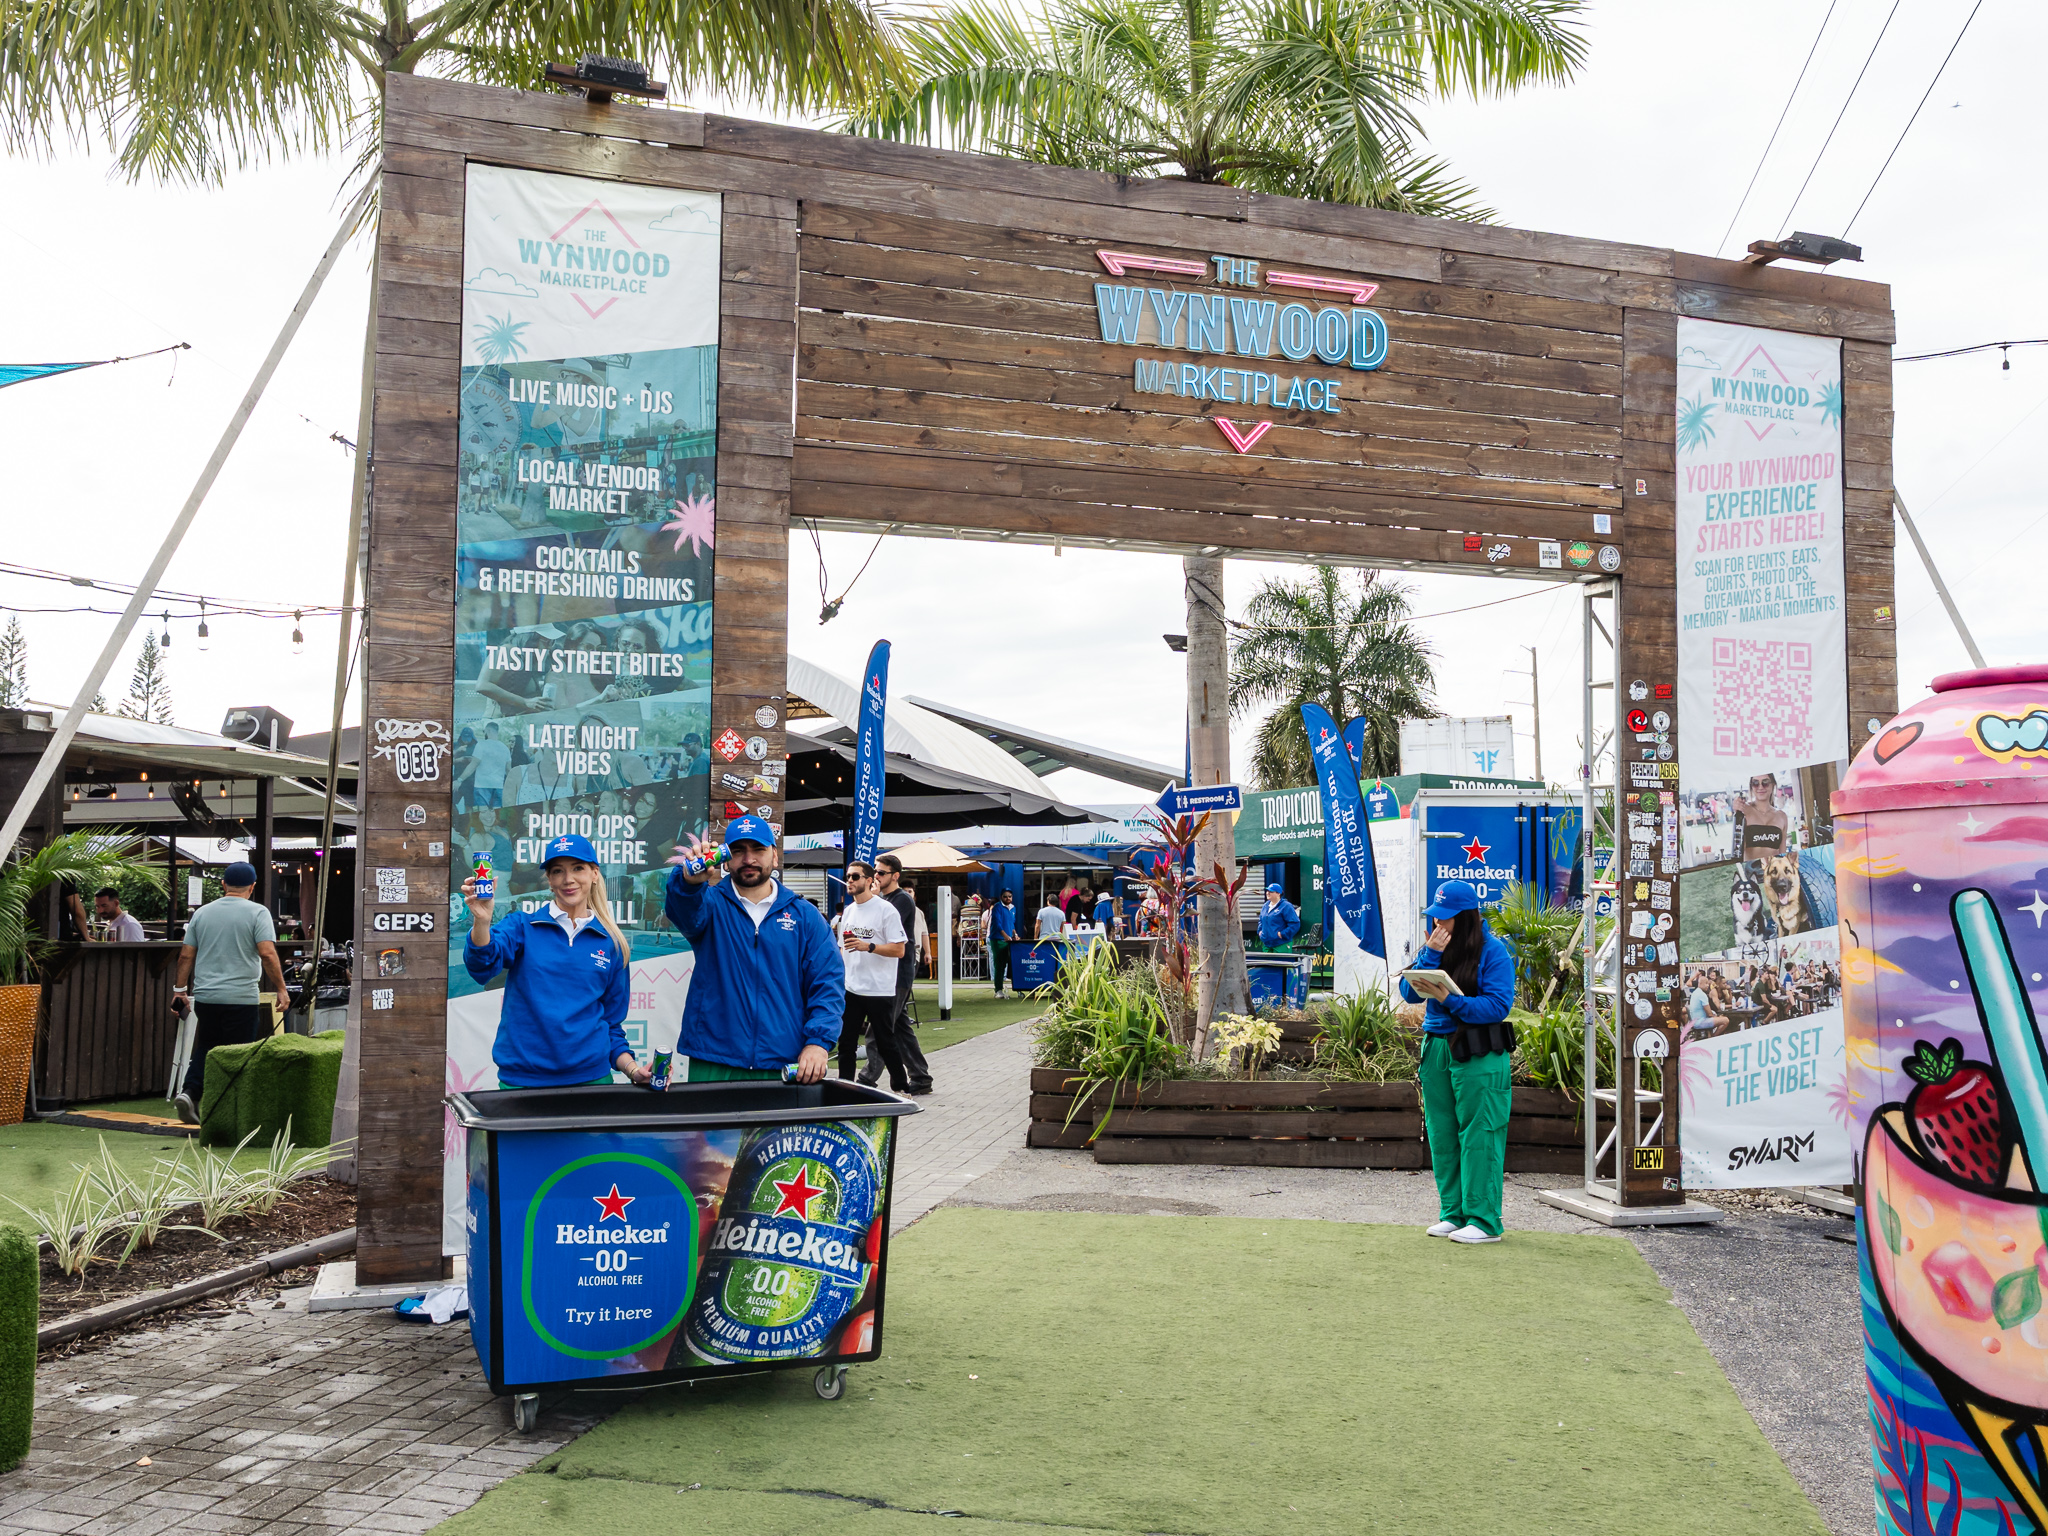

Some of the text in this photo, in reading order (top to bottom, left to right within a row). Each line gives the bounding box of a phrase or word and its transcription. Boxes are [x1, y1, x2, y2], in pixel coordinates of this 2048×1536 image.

[584, 229, 607, 242] THE
[518, 238, 671, 278] WYNWOOD
[1211, 255, 1260, 287] THE
[539, 269, 647, 294] MARKETPLACE
[1094, 283, 1389, 371] WYNWOOD
[1134, 358, 1342, 414] MARKETPLACE
[1752, 368, 1767, 379] THE
[509, 378, 673, 415] LIVE MUSIC + DJS
[1711, 377, 1810, 408] WYNWOOD
[1725, 401, 1795, 421] MARKETPLACE
[518, 458, 661, 491] LOCAL VENDOR
[1685, 452, 1835, 493] YOUR WYNWOOD
[549, 487, 630, 515] MARKET
[1705, 483, 1817, 522] EXPERIENCE
[1697, 512, 1825, 553] STARTS HERE!
[535, 546, 641, 575] COCKTAILS
[1694, 547, 1821, 577] SCAN FOR EVENTS, EATS,
[479, 568, 695, 601] & REFRESHING DRINKS
[1706, 565, 1812, 593] COURTS, PHOTO OPS,
[1704, 581, 1816, 611] GIVEAWAYS & ALL THE
[1683, 609, 1729, 631] MEMORY
[1739, 603, 1780, 622] MAKING
[1783, 595, 1839, 616] MOMENTS.
[486, 645, 684, 677] TASTY STREET BITES
[528, 724, 639, 751] LATE NIGHT
[396, 741, 440, 782] BEE
[556, 751, 611, 775] VIBES
[1660, 763, 1678, 778] AGUS
[723, 773, 748, 787] ORIO
[1327, 770, 1337, 797] on.
[868, 787, 880, 820] off.
[1190, 795, 1224, 805] RESTROOM
[1261, 790, 1325, 829] TROPICOOL
[528, 814, 635, 839] PHOTO OPS
[1342, 804, 1358, 833] off.
[1262, 829, 1297, 843] Superfoods
[1297, 828, 1310, 838] and
[1331, 799, 1357, 898] Resolutions
[1753, 833, 1780, 842] SWARM
[1630, 860, 1654, 877] GENIE
[1631, 851, 1649, 860] FOUR
[1437, 864, 1516, 880] Heineken
[374, 912, 434, 932] GEP$
[1717, 1026, 1823, 1078] LET US SET
[1723, 1059, 1817, 1107] THE VIBE!
[757, 1136, 858, 1181] HEINEKEN 0.0
[1635, 1149, 1662, 1168] DREW
[1727, 1130, 1815, 1171] SWARM
[710, 1217, 860, 1273] Heineken
[595, 1249, 628, 1272] 0.0
[577, 1274, 643, 1286] ALCOHOL FREE
[565, 1307, 652, 1326] Try it here
[745, 1295, 782, 1310] ALCOHOL
[750, 1306, 770, 1318] FREE
[703, 1296, 751, 1343] PREMIUM
[757, 1312, 825, 1345] QUALITY
